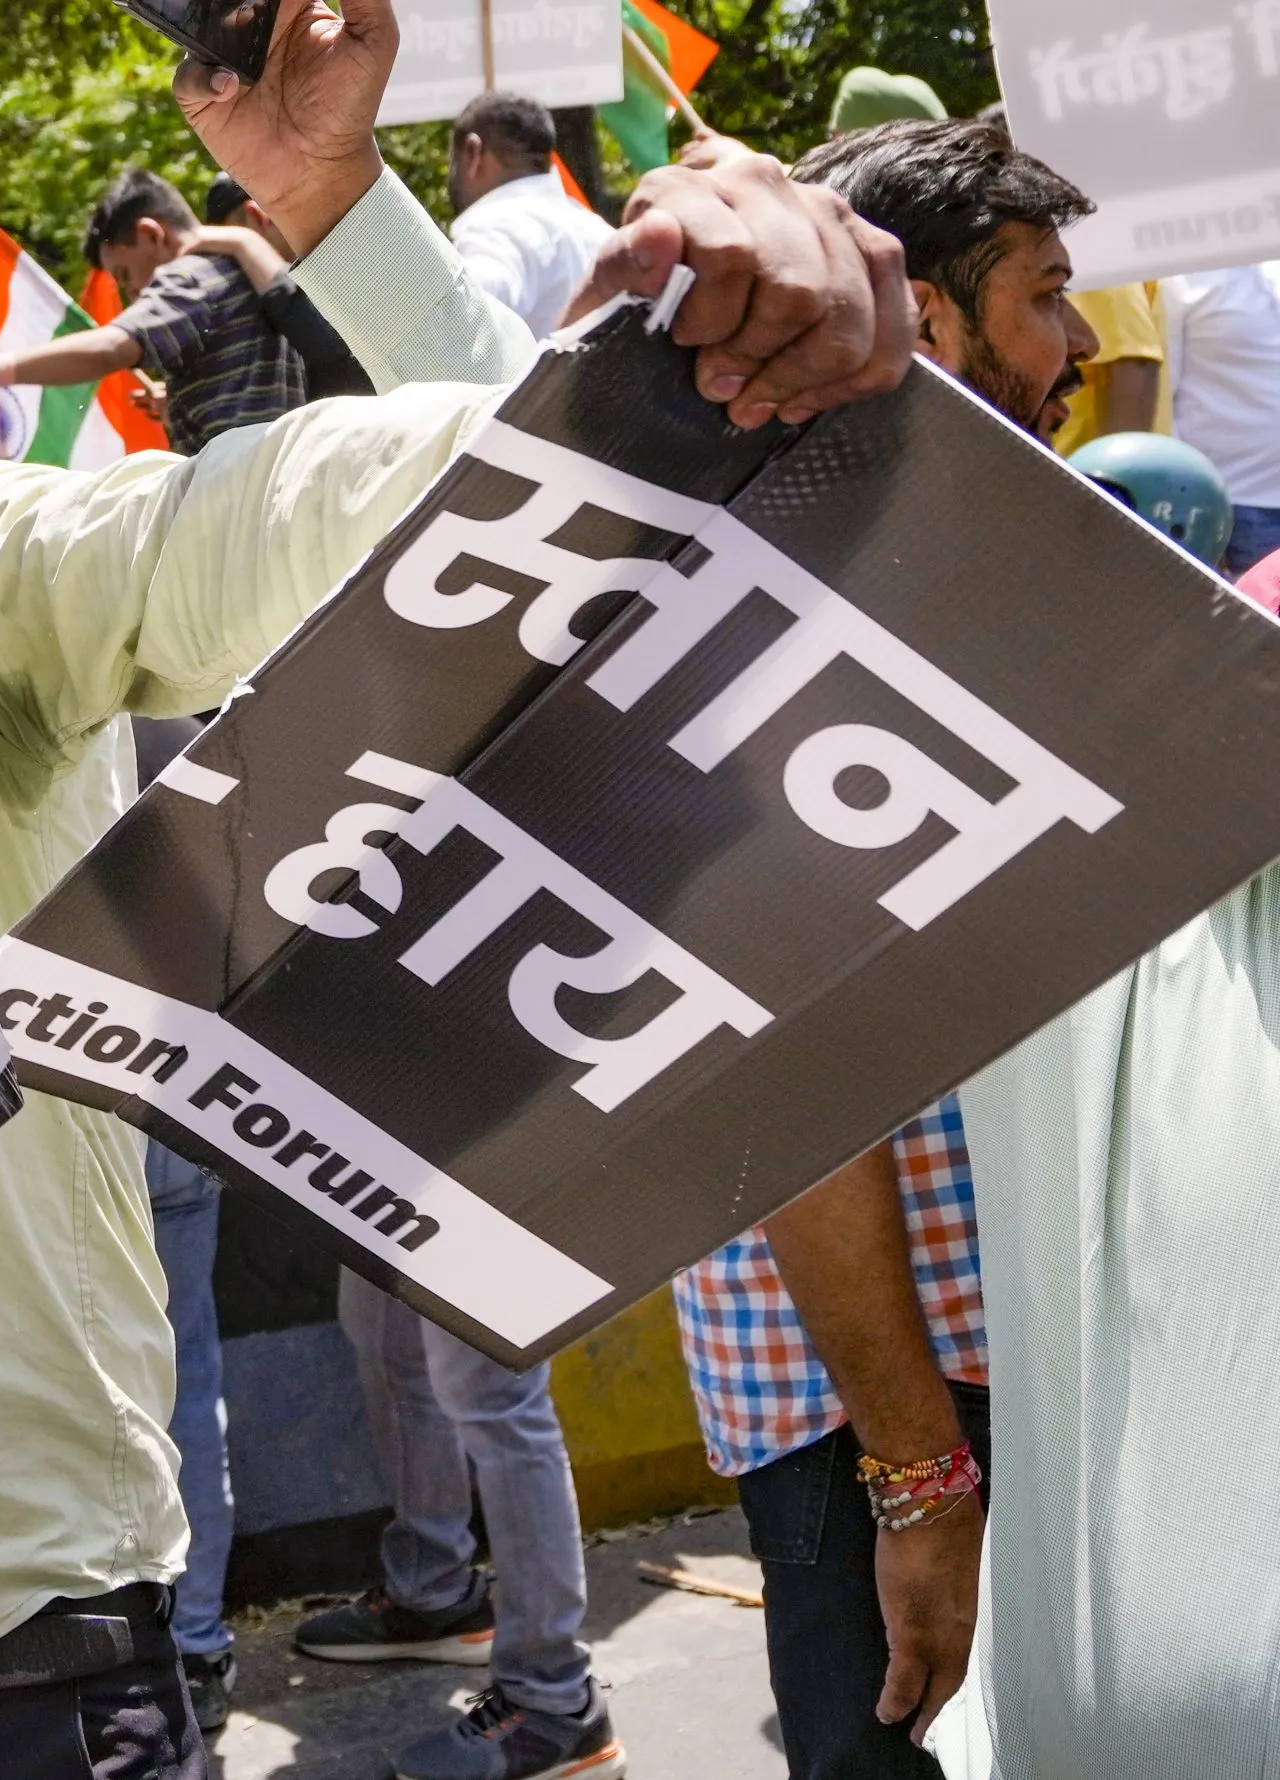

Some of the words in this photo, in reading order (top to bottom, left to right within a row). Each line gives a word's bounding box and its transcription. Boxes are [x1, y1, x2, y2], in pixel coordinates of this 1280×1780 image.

[383, 417, 1125, 931] स्तान
[263, 750, 776, 1114] हाय
[186, 1062, 440, 1253] Forum
